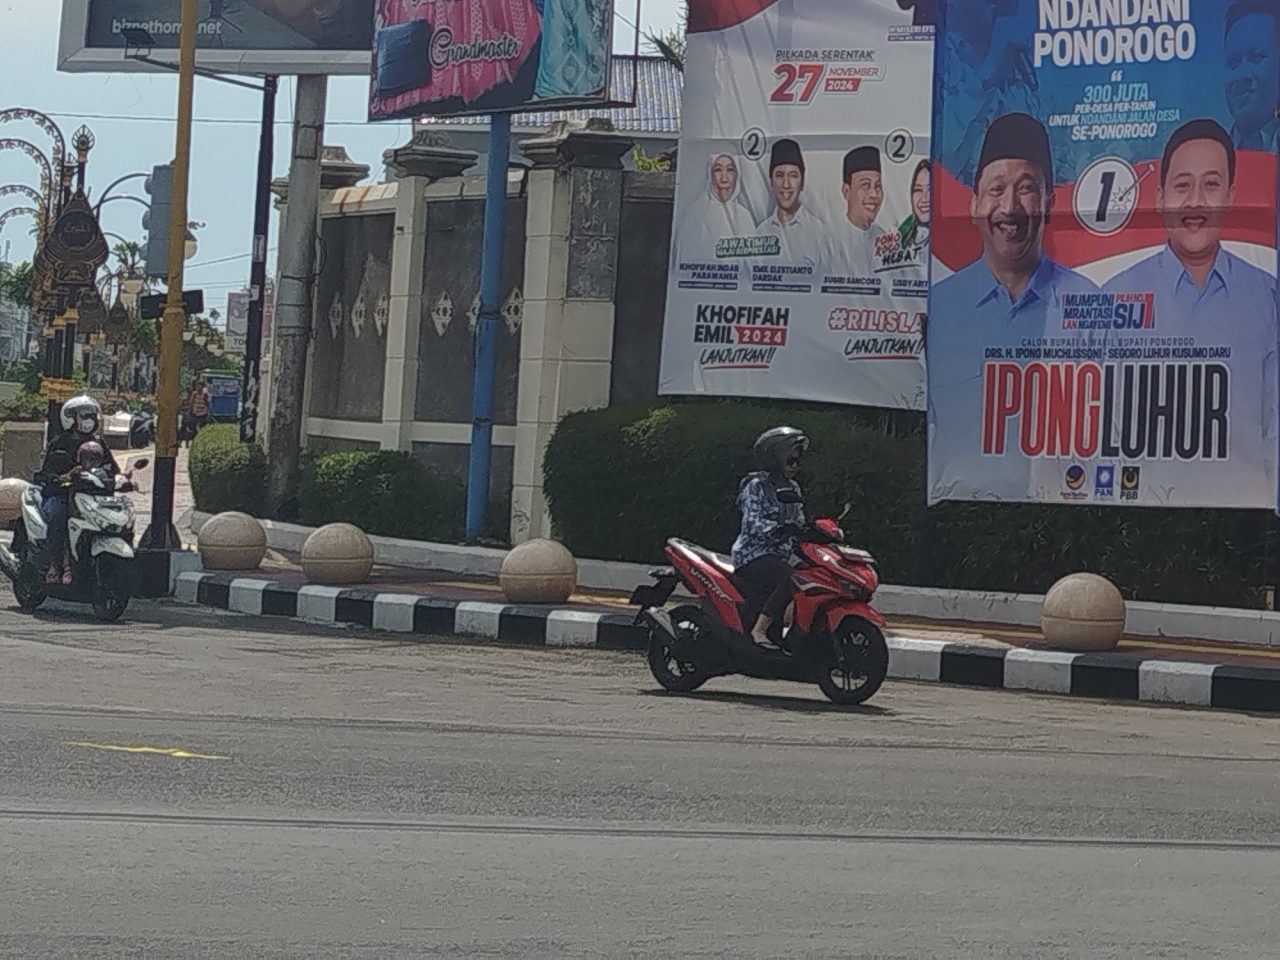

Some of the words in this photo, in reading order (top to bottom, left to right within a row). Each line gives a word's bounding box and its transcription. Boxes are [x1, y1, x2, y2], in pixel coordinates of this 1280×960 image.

[429, 26, 522, 72] Grandmaster
[776, 50, 819, 59] PILKADA
[821, 49, 875, 59] SERENTAK
[1034, 24, 1196, 67] PONOROGO
[829, 67, 879, 77] NOVEMBER
[770, 63, 825, 102] 27
[827, 79, 854, 90] 2024
[1083, 84, 1112, 103] 300
[1113, 82, 1149, 101] JUTA
[1049, 114, 1079, 126] UNTUK
[1080, 112, 1125, 125] NDANDANI
[1127, 111, 1156, 122] JALAN
[1157, 109, 1180, 121] DESA
[1072, 122, 1157, 140] SE-PONOROGO
[747, 133, 760, 156] 2
[892, 135, 907, 158] 2
[1095, 171, 1115, 223] 1
[696, 304, 790, 326] KHOFIFAH
[694, 325, 735, 344] EMIL
[743, 328, 782, 343] 2024
[1062, 320, 1077, 330] LAN
[700, 347, 777, 364] LANJUTKAN!!
[985, 348, 1005, 359] DRS.
[1007, 348, 1014, 359] H.
[1015, 348, 1042, 359] IPONG
[1108, 348, 1142, 359] SEGORO
[1143, 348, 1170, 359] LUHUR
[1171, 348, 1207, 359] KUSUMO
[1209, 348, 1231, 359] DARU
